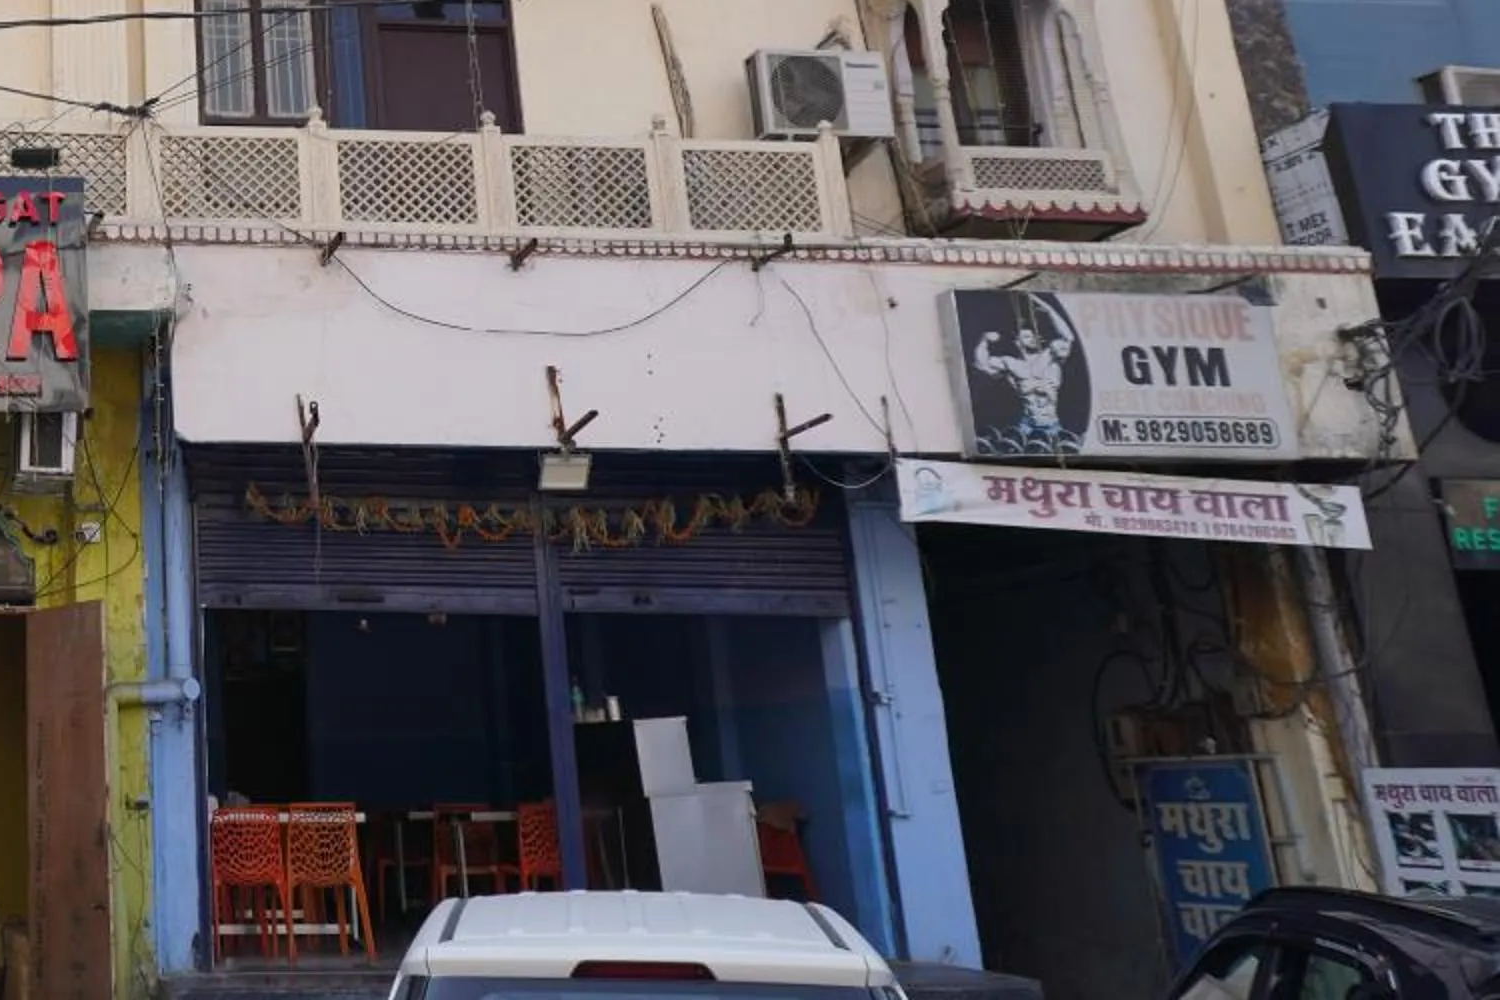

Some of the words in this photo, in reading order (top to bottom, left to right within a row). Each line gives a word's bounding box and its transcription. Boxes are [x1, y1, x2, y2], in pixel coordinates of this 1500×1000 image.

[1080, 298, 1255, 342] PHYSIQUE
[1120, 345, 1232, 388] GYM
[1135, 420, 1275, 445] 9829058689
[981, 475, 1092, 519] मथुरा
[1098, 483, 1182, 516] चाय
[1188, 489, 1291, 523] वाला
[1372, 783, 1415, 809] मथुरा
[1155, 802, 1251, 855] मथुरा
[1177, 859, 1250, 900] चाय
